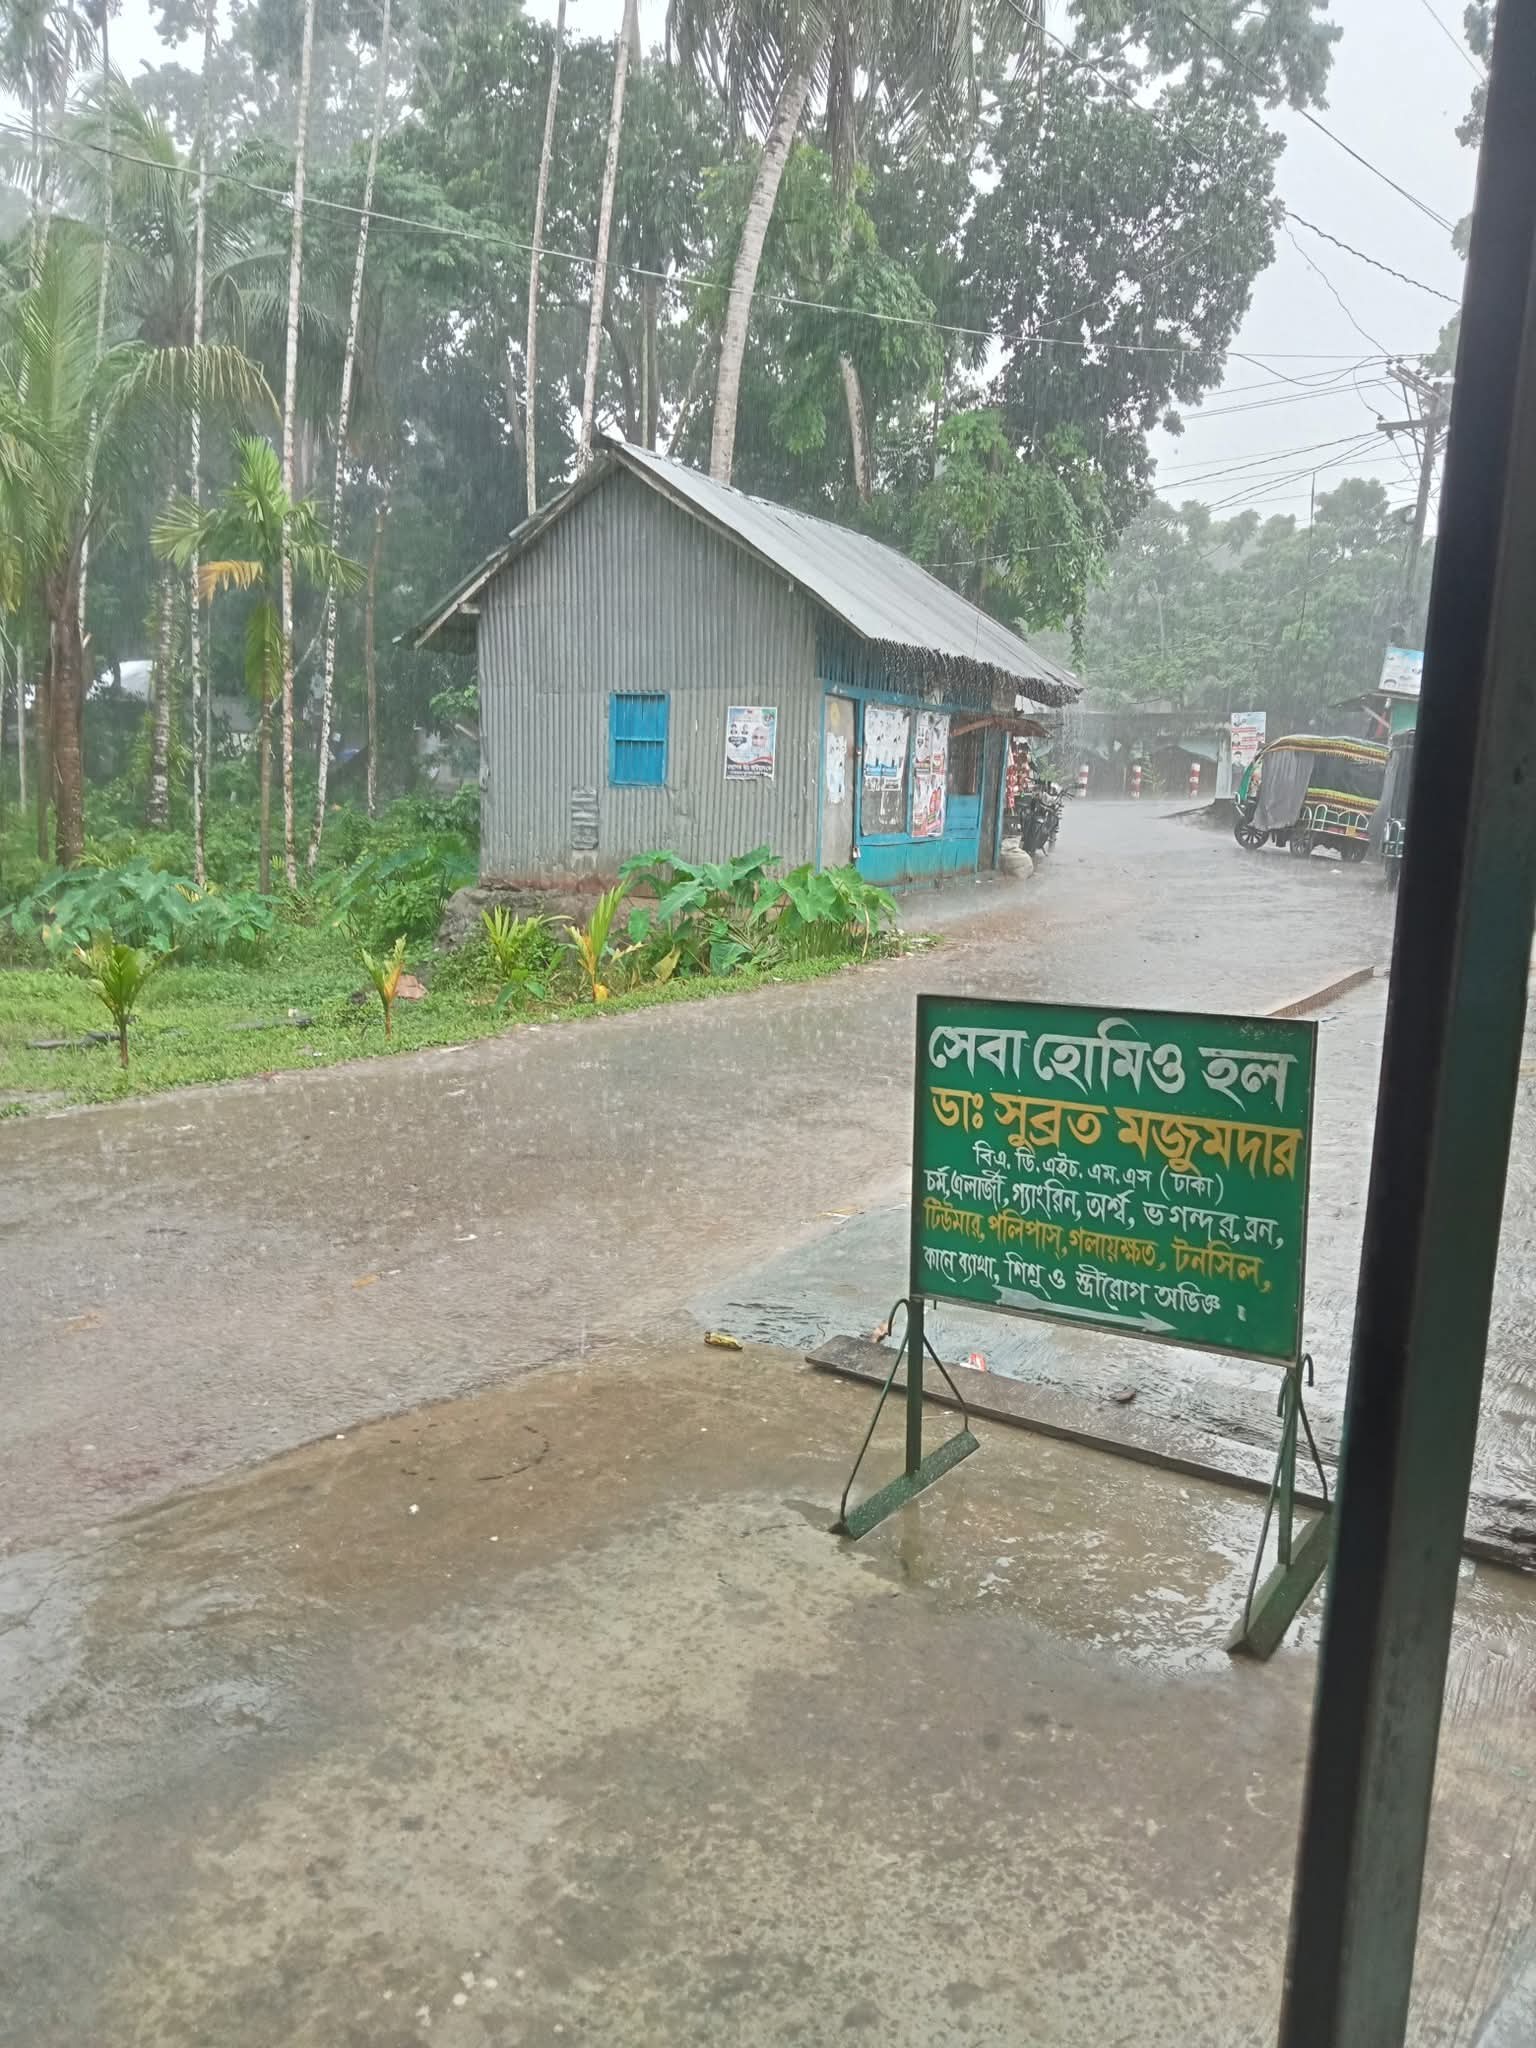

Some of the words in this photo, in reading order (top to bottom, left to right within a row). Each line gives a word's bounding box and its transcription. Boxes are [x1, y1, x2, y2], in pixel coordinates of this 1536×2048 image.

[928, 1026, 1029, 1079] সেবা
[1033, 1017, 1185, 1095] হোমিও
[1198, 1047, 1298, 1112] হল
[930, 1086, 984, 1133] ডাঃ
[990, 1092, 1109, 1154] সুব্রত
[1114, 1106, 1303, 1182] মজুমদার
[1003, 1251, 1051, 1300] শিশু
[1048, 1268, 1066, 1289] ও
